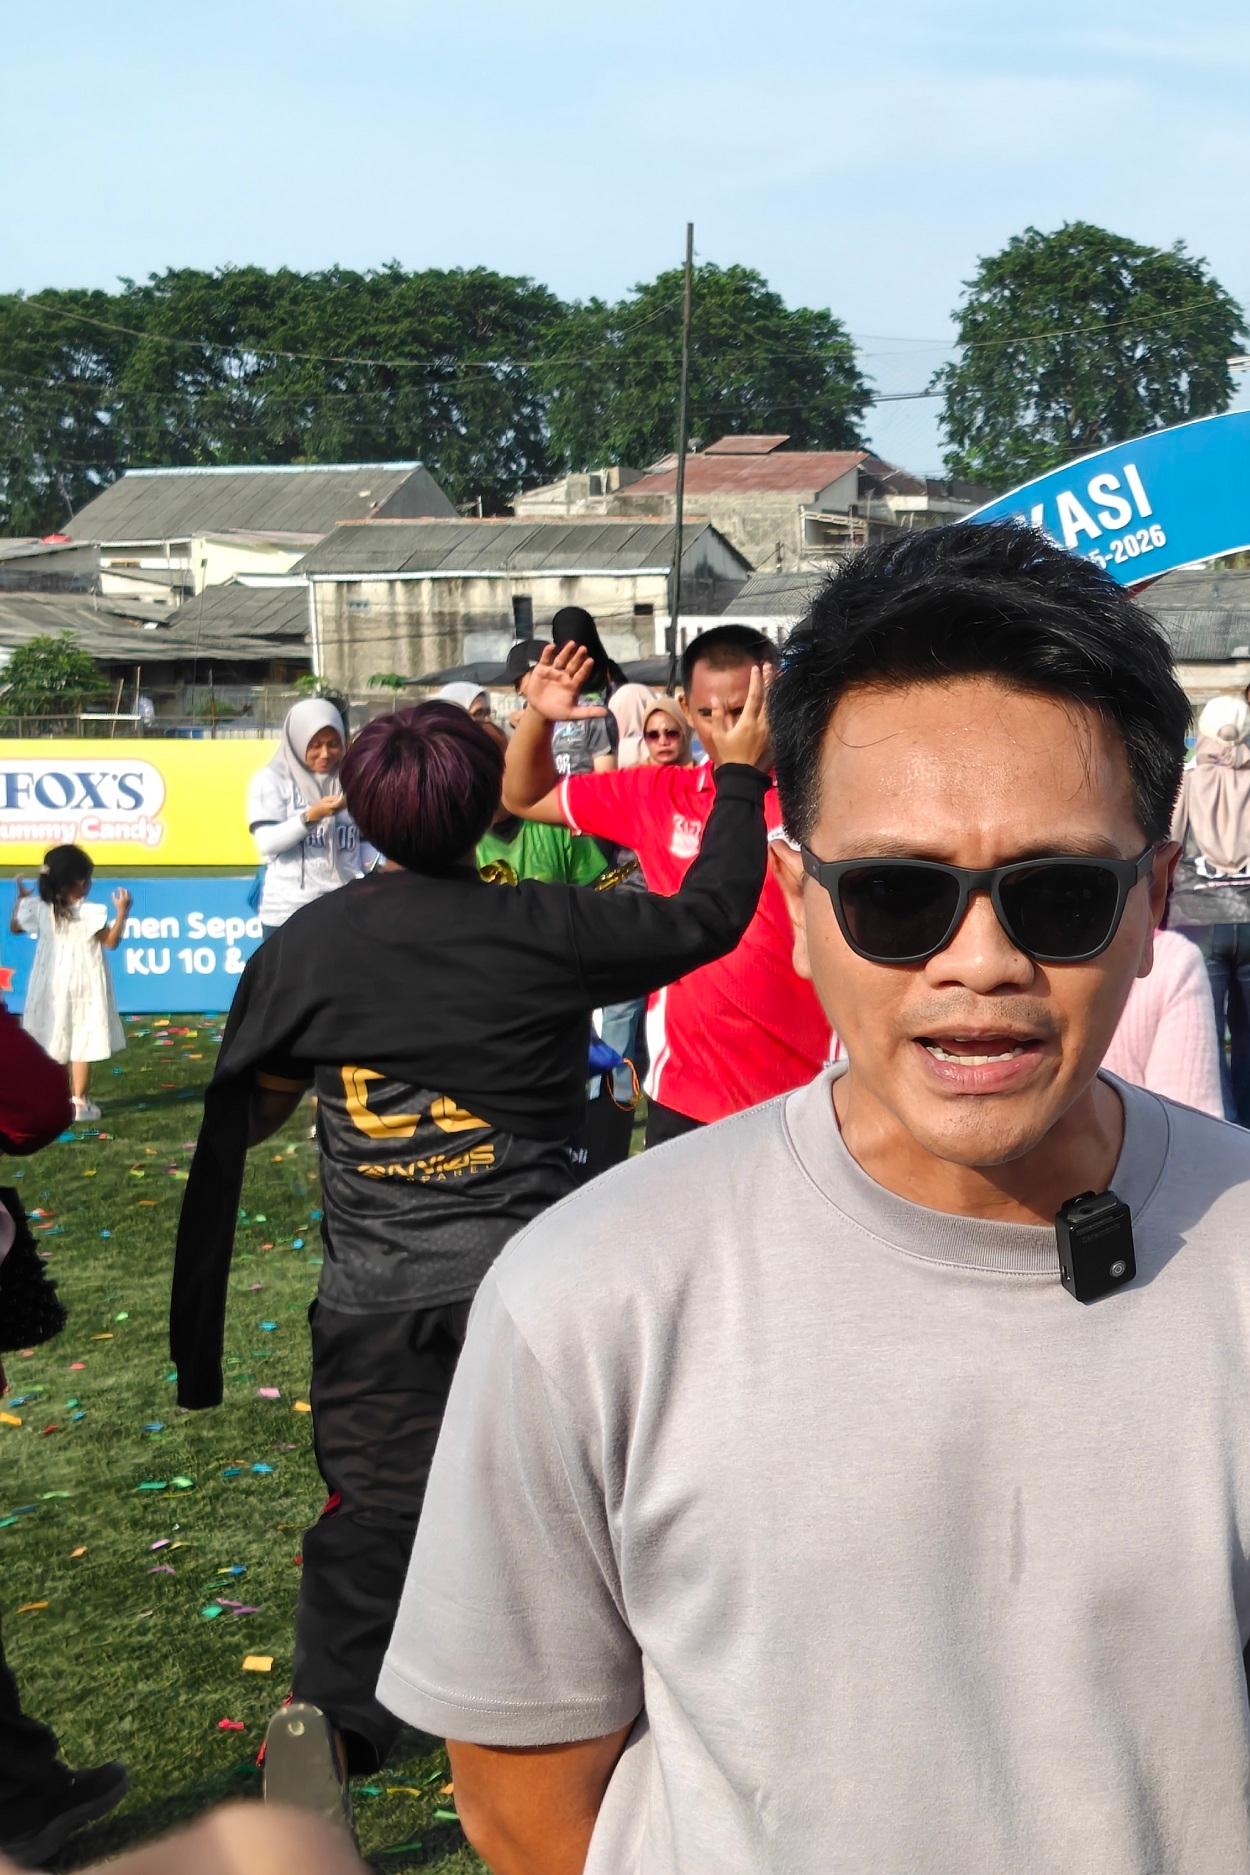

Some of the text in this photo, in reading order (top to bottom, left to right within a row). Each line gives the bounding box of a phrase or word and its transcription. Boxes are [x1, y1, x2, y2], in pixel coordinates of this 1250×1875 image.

[0, 772, 145, 811] FOX'S
[0, 815, 162, 848] ummy Candy
[187, 911, 263, 946] Sepa
[126, 947, 171, 975] KU
[178, 947, 216, 975] 10
